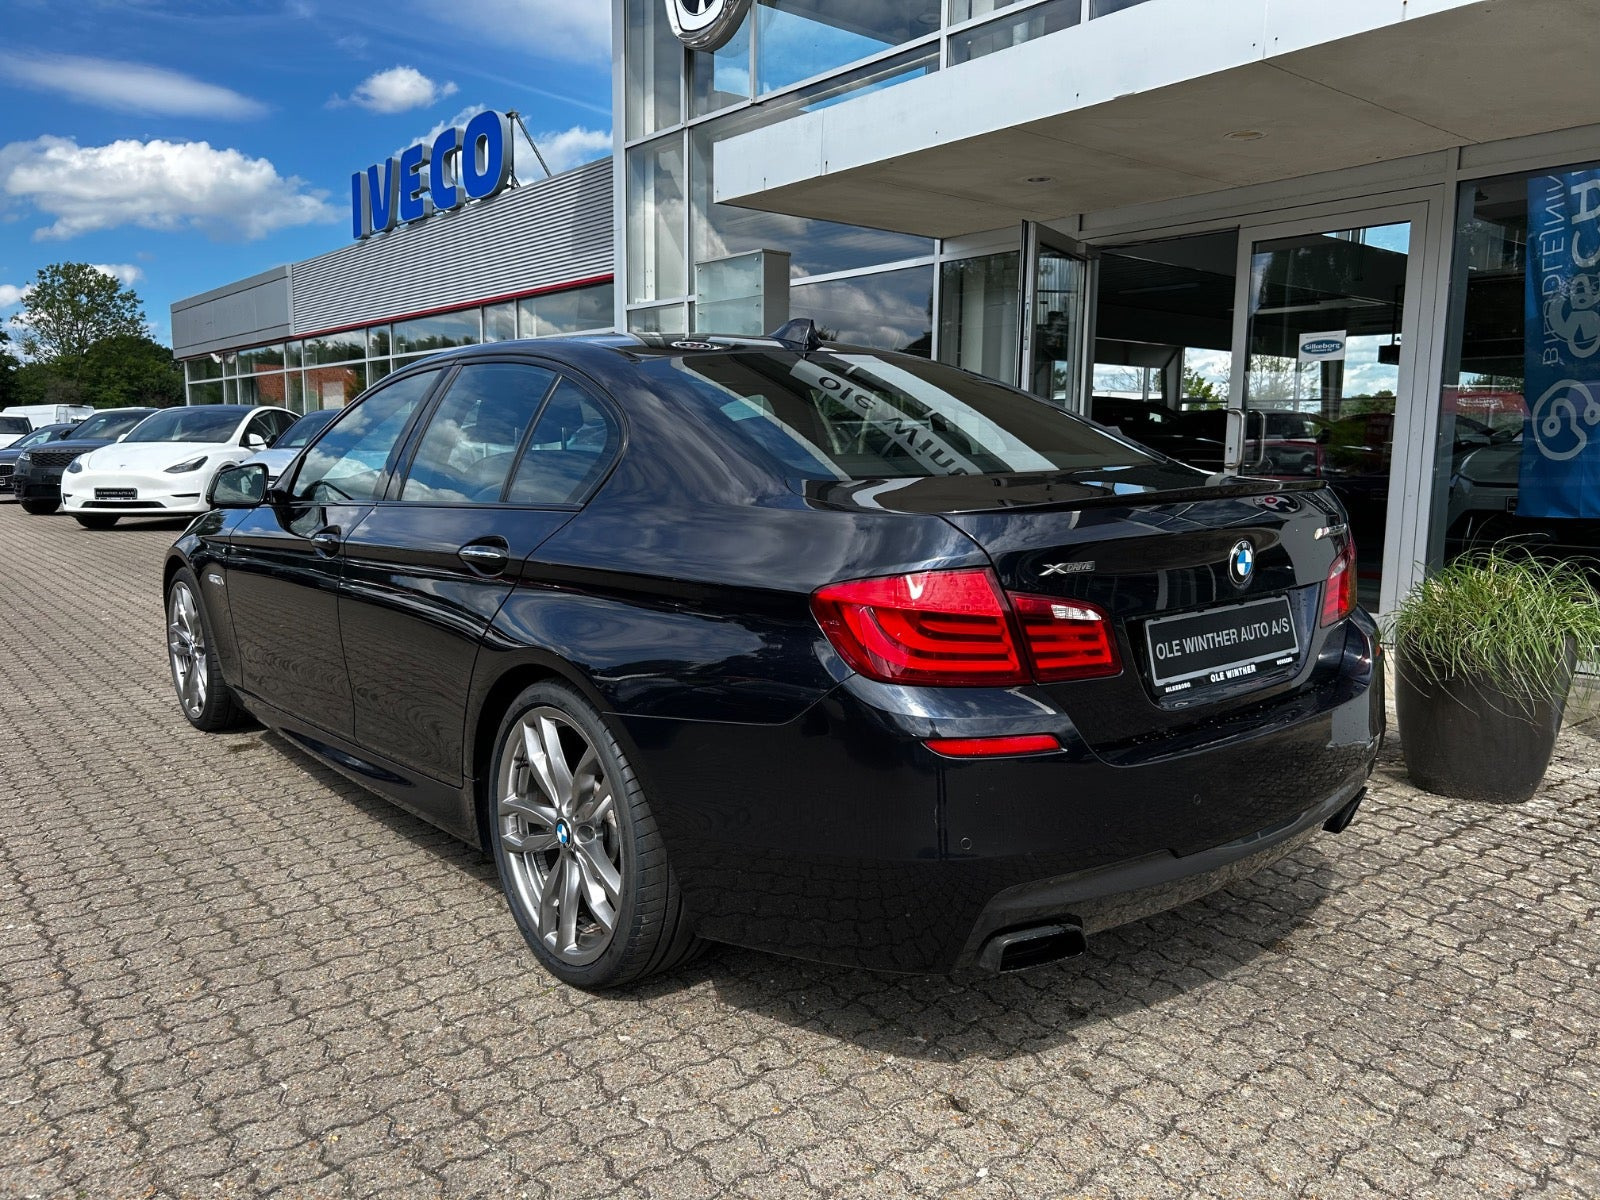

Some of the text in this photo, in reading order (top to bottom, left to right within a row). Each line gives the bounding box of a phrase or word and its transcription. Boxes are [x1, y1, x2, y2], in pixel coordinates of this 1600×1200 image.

[352, 110, 511, 240] IVECO
[1156, 617, 1290, 660] OLE WINTHER AUTO A/S
[1210, 664, 1257, 683] OLE WINTHER
